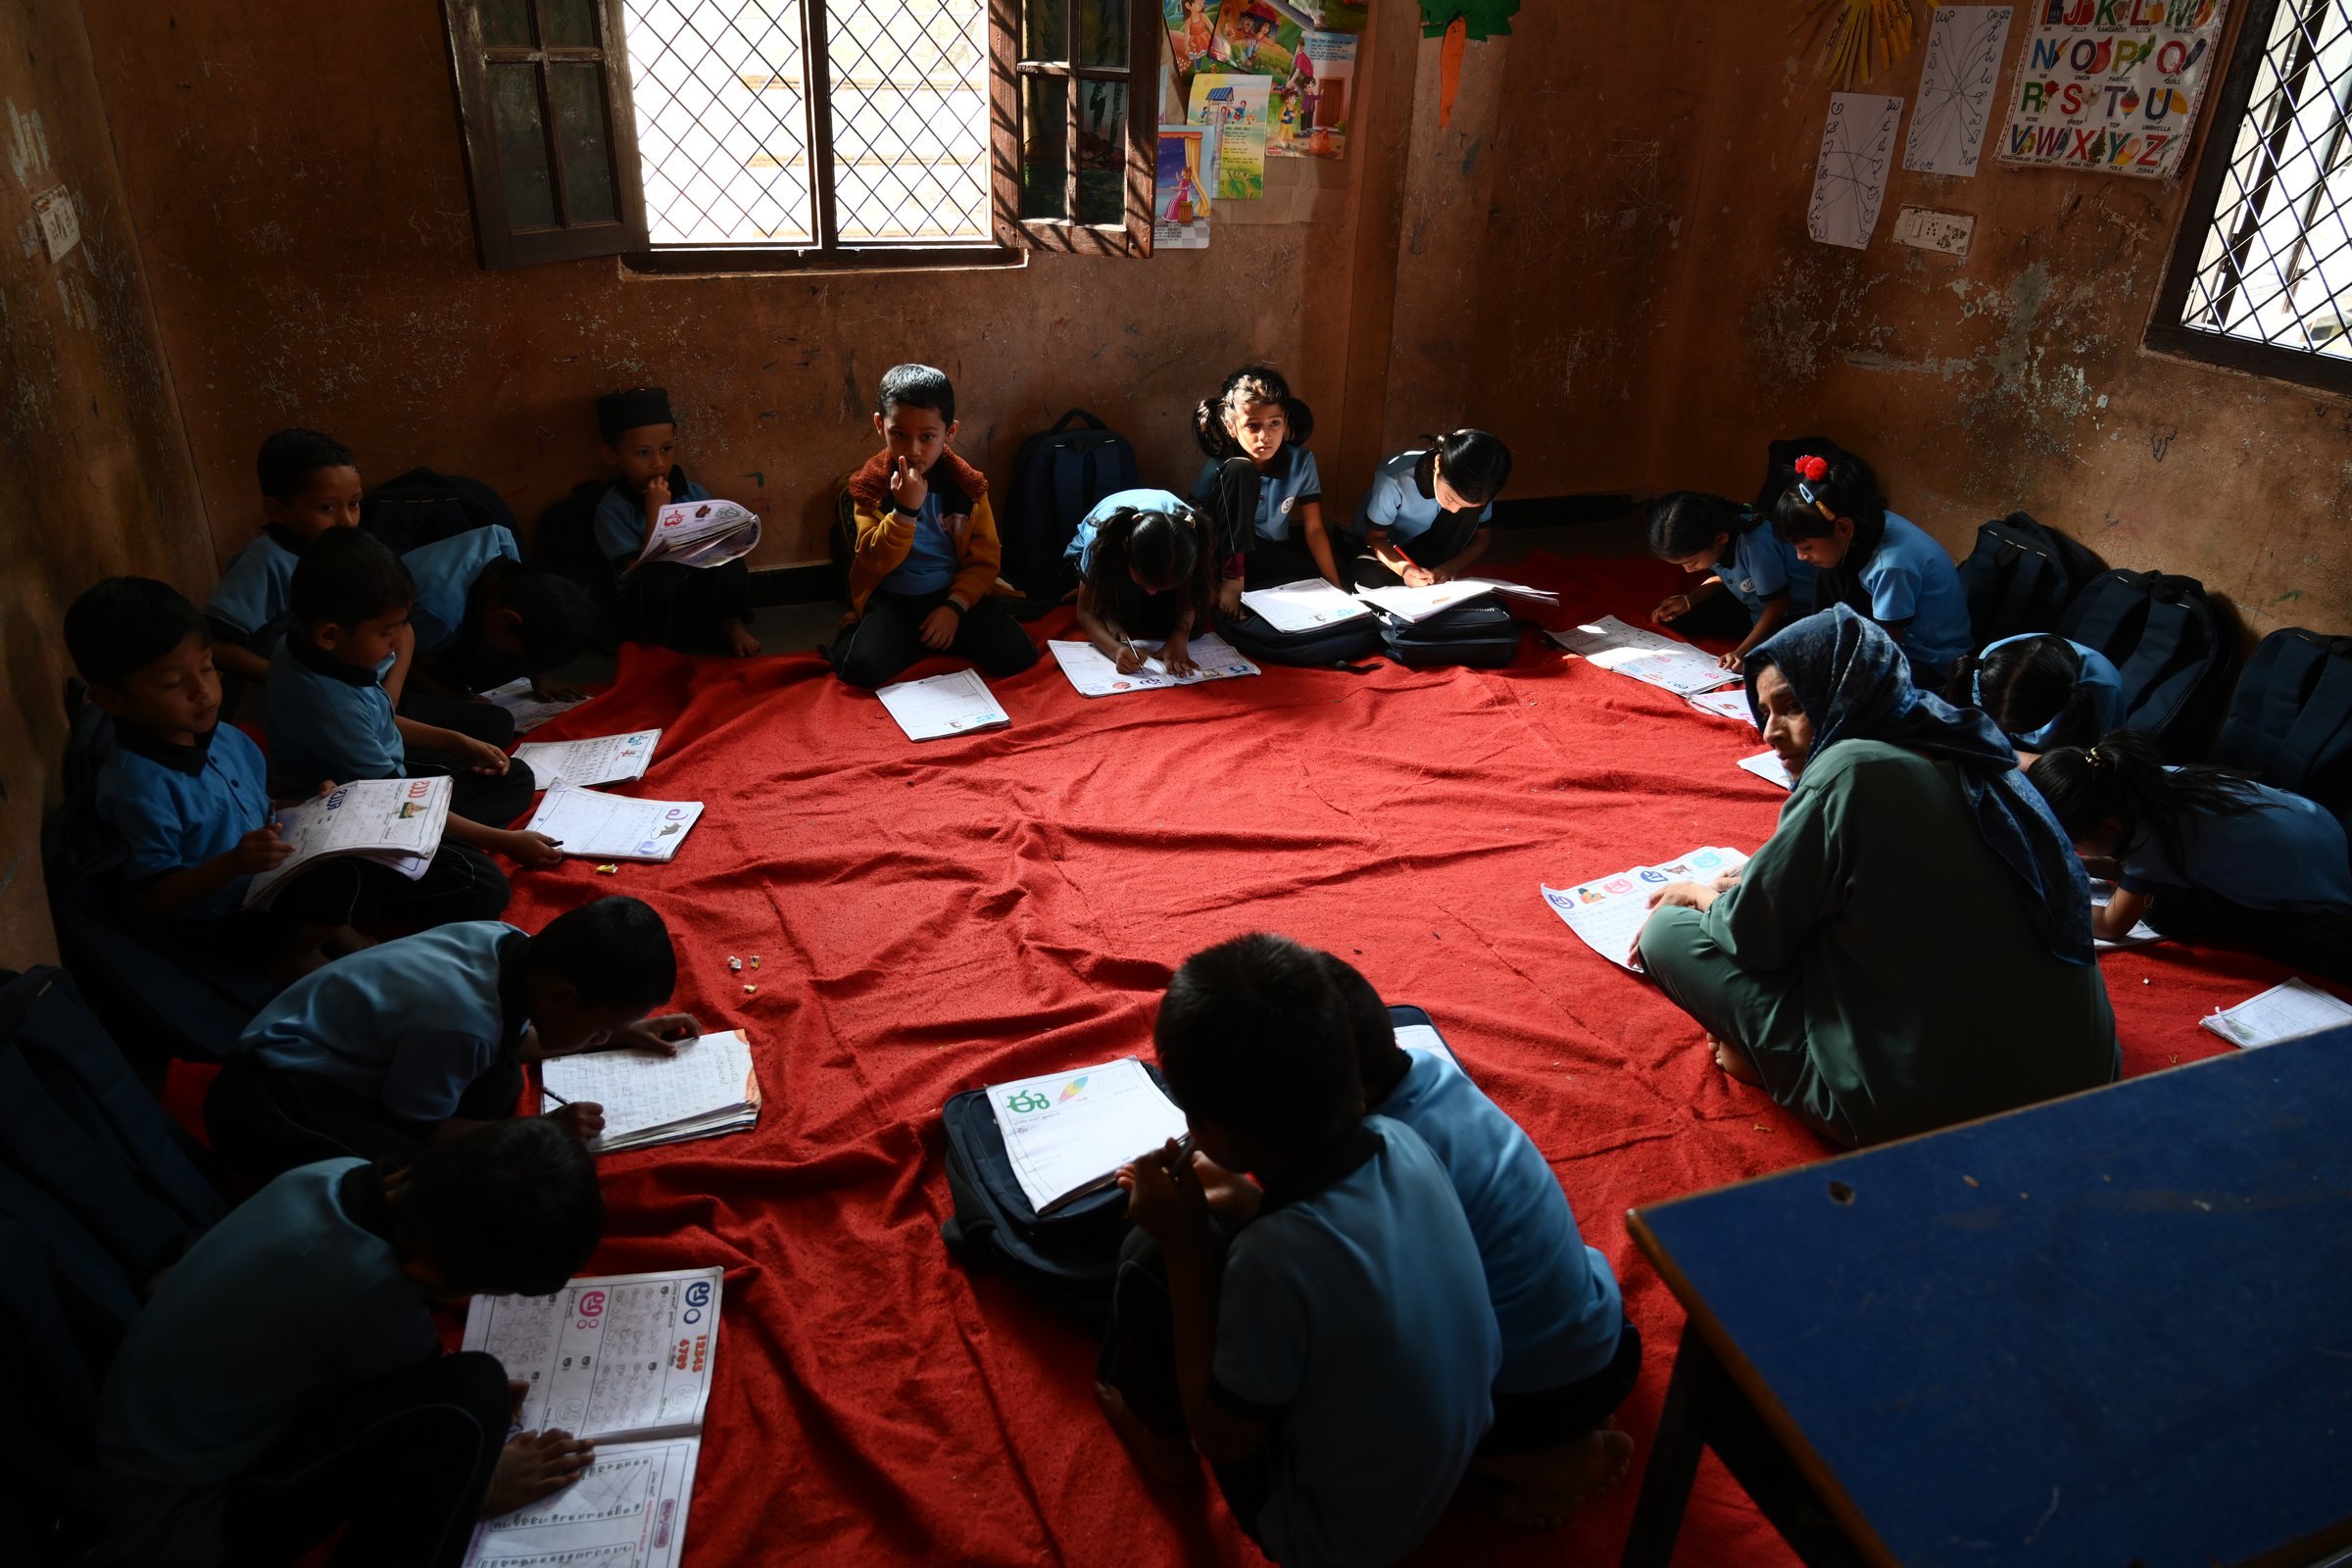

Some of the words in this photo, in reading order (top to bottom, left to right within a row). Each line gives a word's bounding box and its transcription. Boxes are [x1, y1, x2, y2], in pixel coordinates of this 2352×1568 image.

[2062, 0, 2083, 25] J
[2094, 0, 2120, 25] K
[2130, 0, 2150, 26] L
[2165, 0, 2201, 27] M
[2031, 38, 2056, 71] N
[2070, 38, 2097, 72] O
[2111, 39, 2137, 73] P
[2156, 40, 2187, 75] Q
[2165, 76, 2181, 85] QUILL
[2021, 81, 2044, 113] R
[2060, 83, 2083, 115] S
[2104, 85, 2129, 118] T
[2144, 87, 2174, 121] U
[2012, 123, 2034, 153] V
[2035, 126, 2065, 156] W
[2066, 128, 2096, 160] X
[2107, 131, 2132, 163] Y
[2136, 134, 2169, 167] Z
[2141, 123, 2172, 132] UMBRELLA
[683, 1282, 710, 1325] అం
[675, 1339, 691, 1370] 6789
[692, 1334, 708, 1373] 12345
